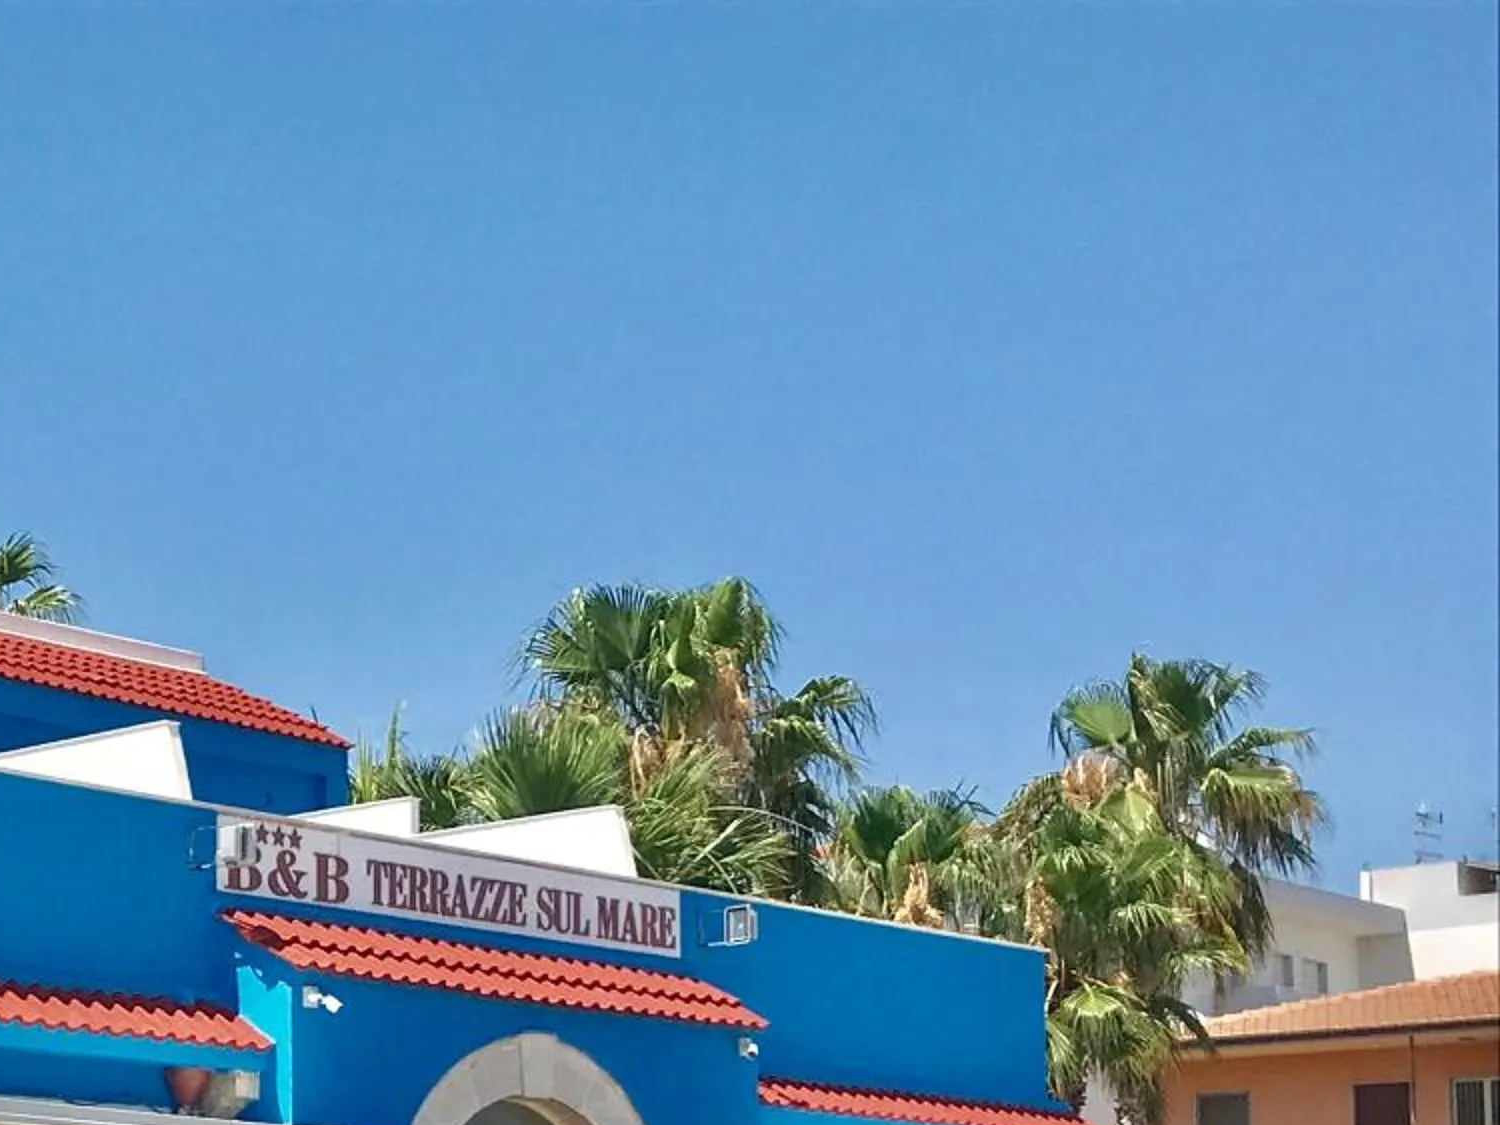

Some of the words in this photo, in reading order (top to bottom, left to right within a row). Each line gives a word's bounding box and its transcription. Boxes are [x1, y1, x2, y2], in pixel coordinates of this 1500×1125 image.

[366, 859, 528, 927] TERRAZZE
[536, 886, 591, 937] SUL
[596, 895, 677, 949] MARE
